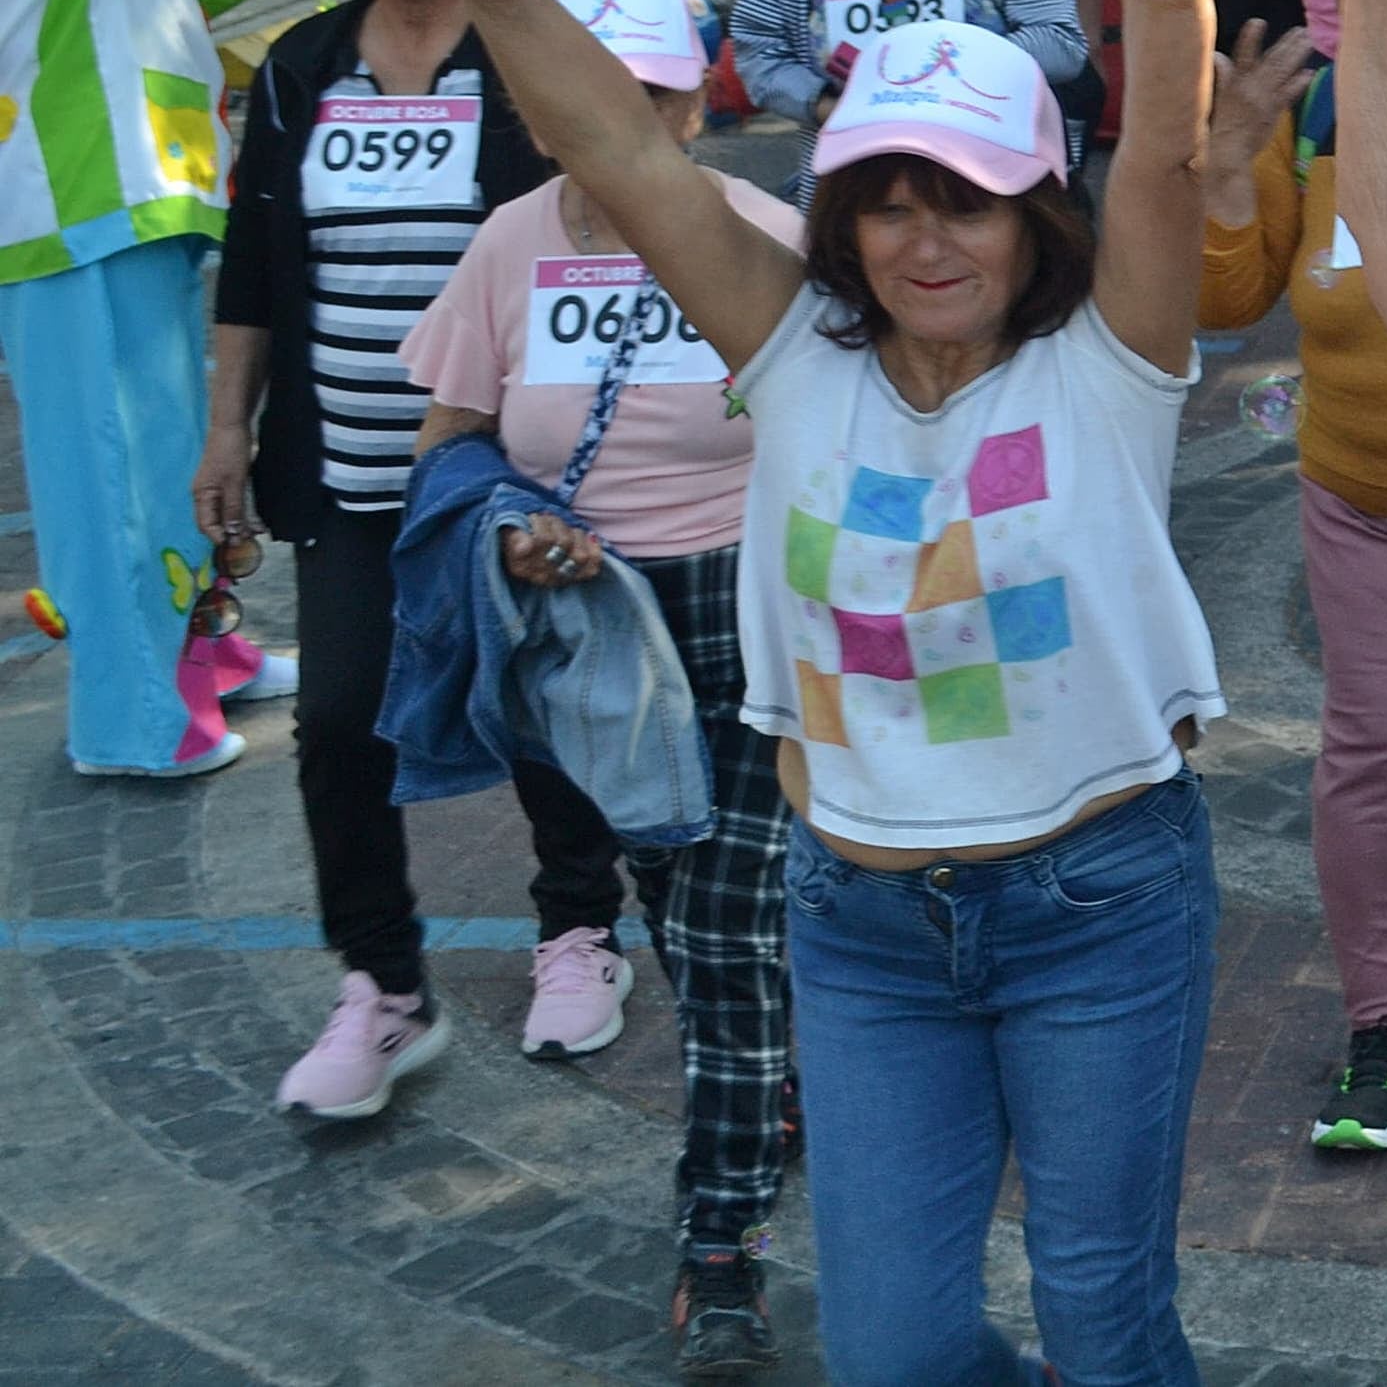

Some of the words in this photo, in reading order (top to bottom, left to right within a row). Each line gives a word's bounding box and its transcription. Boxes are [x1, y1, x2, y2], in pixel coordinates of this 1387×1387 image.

[328, 105, 402, 119] OCTUBRE
[405, 105, 449, 119] ROSA
[323, 128, 454, 172] 0599
[563, 265, 644, 283] OCTUBRE
